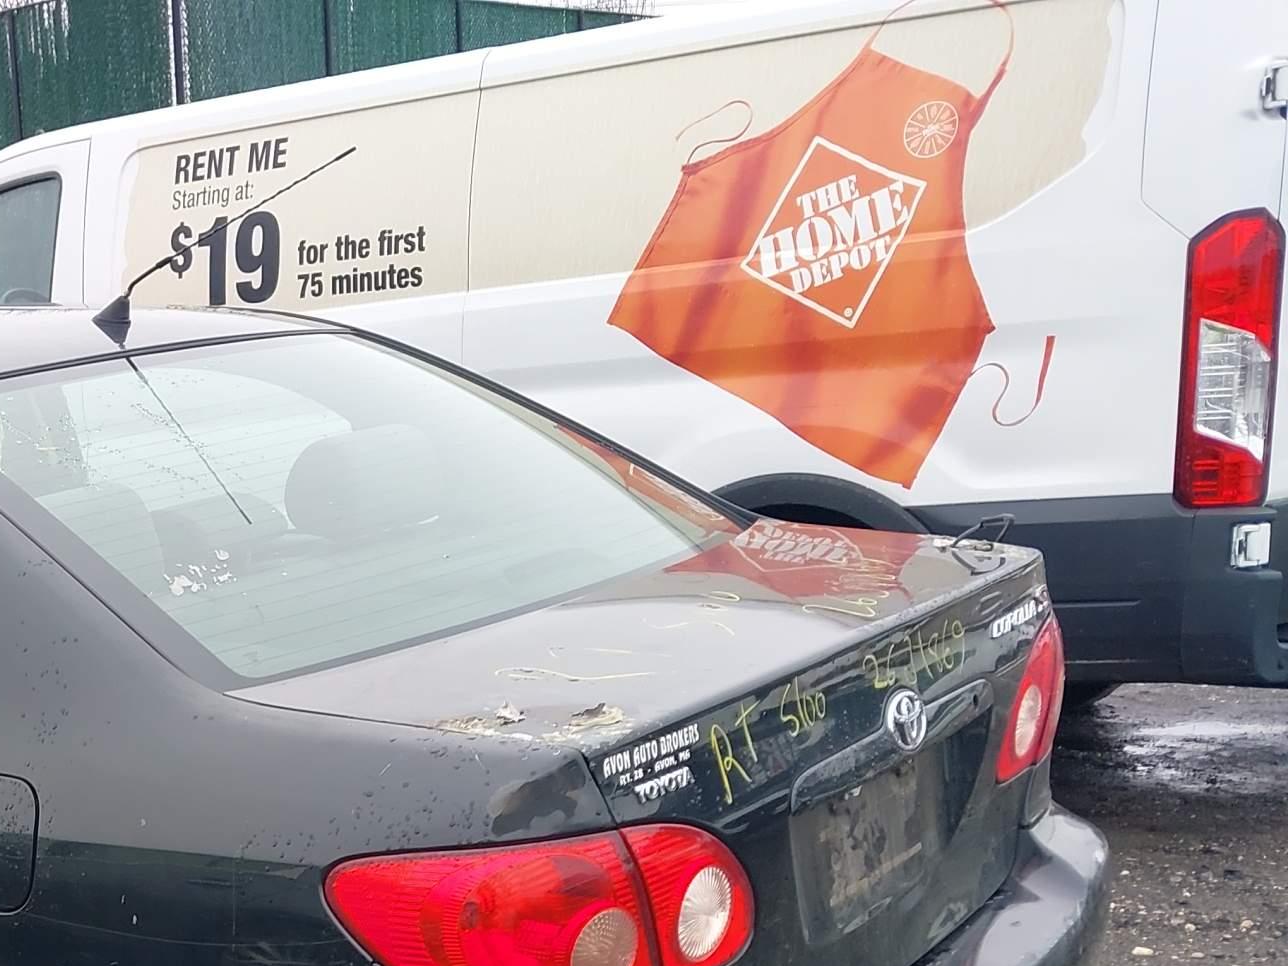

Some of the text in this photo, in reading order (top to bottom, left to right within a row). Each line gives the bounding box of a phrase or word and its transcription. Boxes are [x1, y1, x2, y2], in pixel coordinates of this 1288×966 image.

[175, 137, 288, 184] RENT ME
[172, 180, 254, 210] Starting at:
[796, 175, 860, 218] THE
[298, 226, 426, 265] for the first
[760, 180, 909, 278] HOME
[170, 211, 280, 306] $19
[790, 235, 891, 294] DEPOT
[298, 264, 423, 299] 75 minutes
[603, 723, 699, 779] AVON AUTO BROKERS
[634, 766, 695, 804] TOYOTA
